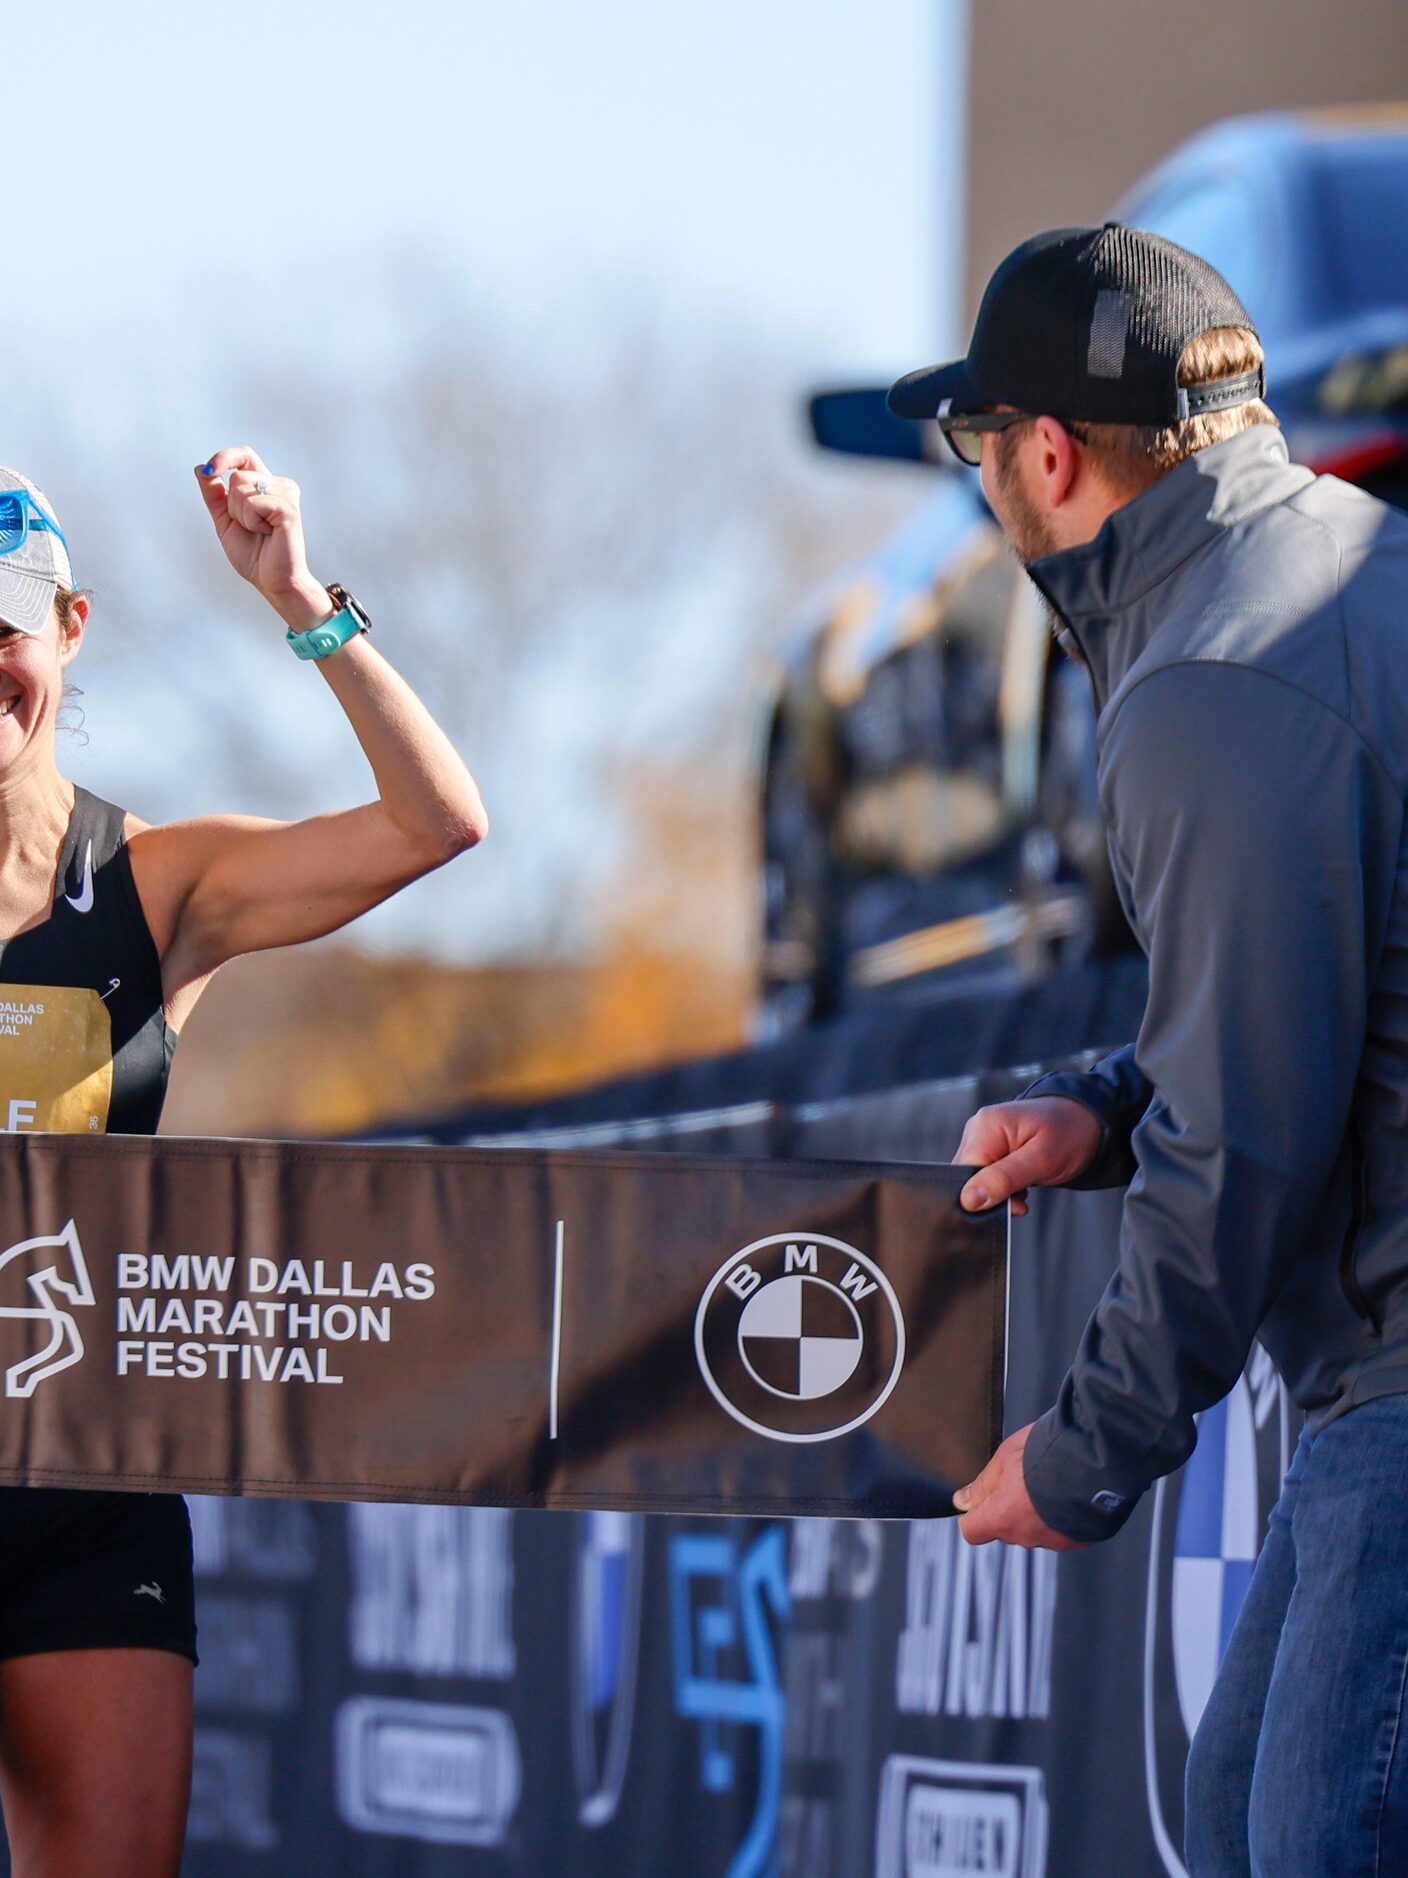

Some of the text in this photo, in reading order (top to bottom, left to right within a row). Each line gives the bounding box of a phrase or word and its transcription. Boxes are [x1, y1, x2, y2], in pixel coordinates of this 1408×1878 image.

[118, 1253, 436, 1300] BMW DALLAS
[724, 1244, 879, 1301] BMW
[117, 1297, 391, 1342] MARATHON
[117, 1340, 344, 1384] FESTIVAL
